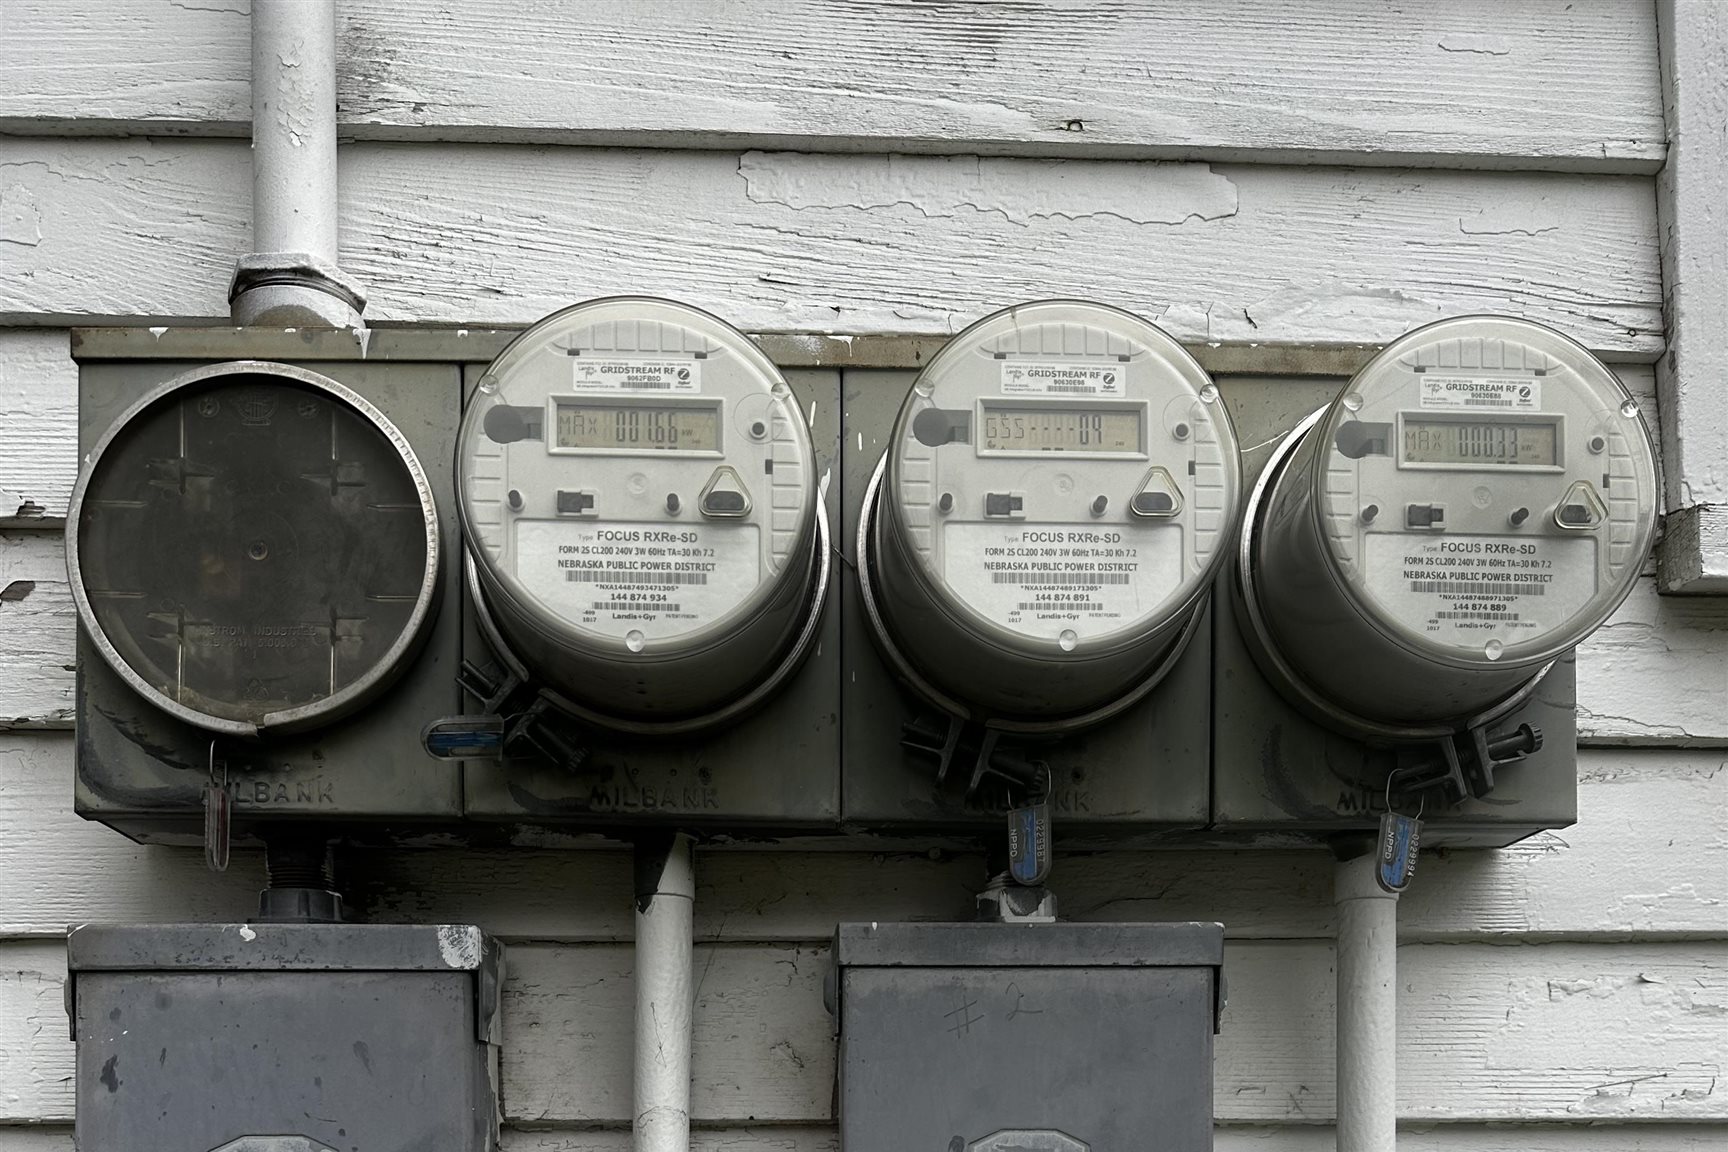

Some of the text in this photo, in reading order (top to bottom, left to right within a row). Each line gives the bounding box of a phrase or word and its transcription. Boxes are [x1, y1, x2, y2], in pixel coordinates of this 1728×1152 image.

[600, 366, 661, 375] GRIDSTREAM
[664, 367, 675, 375] RF
[1028, 369, 1087, 379] GRIDSTREAM
[1089, 371, 1101, 379] RF
[1445, 383, 1504, 392] GRIDSTREAM
[1506, 385, 1517, 393] RF
[559, 415, 598, 435] MAX
[1405, 430, 1441, 450] MAX
[597, 531, 640, 541] FOCUS
[644, 532, 698, 543] RXRe-SD
[1022, 532, 1064, 543] FOCUS
[1068, 533, 1121, 543] RXRe-SD
[559, 545, 715, 557] FORM 2S CL200 240V 3W 60Hz TA=30 Kh 7.2
[985, 548, 1004, 556] FORM
[1007, 548, 1015, 556] 2S
[1017, 548, 1038, 556] CL200
[1072, 549, 1089, 557] 60Hz
[1091, 549, 1113, 557] TA=30
[1115, 549, 1124, 557] Kh
[1126, 549, 1137, 557] 7.2
[1441, 542, 1481, 553] FOCUS
[1485, 543, 1536, 554] RXRe-SD
[558, 560, 716, 571] NEBRASKA PUBLIC POWER DISTRICT
[984, 562, 1138, 571] NEBRASKA PUBLIC POWER DISTRICT
[1404, 556, 1552, 568] FORM 2S CL200 240V 3W 60Hz TA=30 Kh 7.2
[1404, 570, 1553, 582] NEBRASKA PUBLIC POWER DISTRICT
[611, 593, 667, 602] 144 874 934
[1472, 603, 1488, 611] 874
[612, 613, 656, 621] Landis+Gyr
[1037, 613, 1080, 621] Landis+Gyr
[1455, 622, 1496, 630] Landis+Gyr
[201, 781, 334, 803] LBANK
[590, 785, 719, 809] MILBANK
[1010, 829, 1018, 857] NPPD
[1385, 832, 1394, 859] NPPD
[1407, 834, 1419, 877] 0229994
